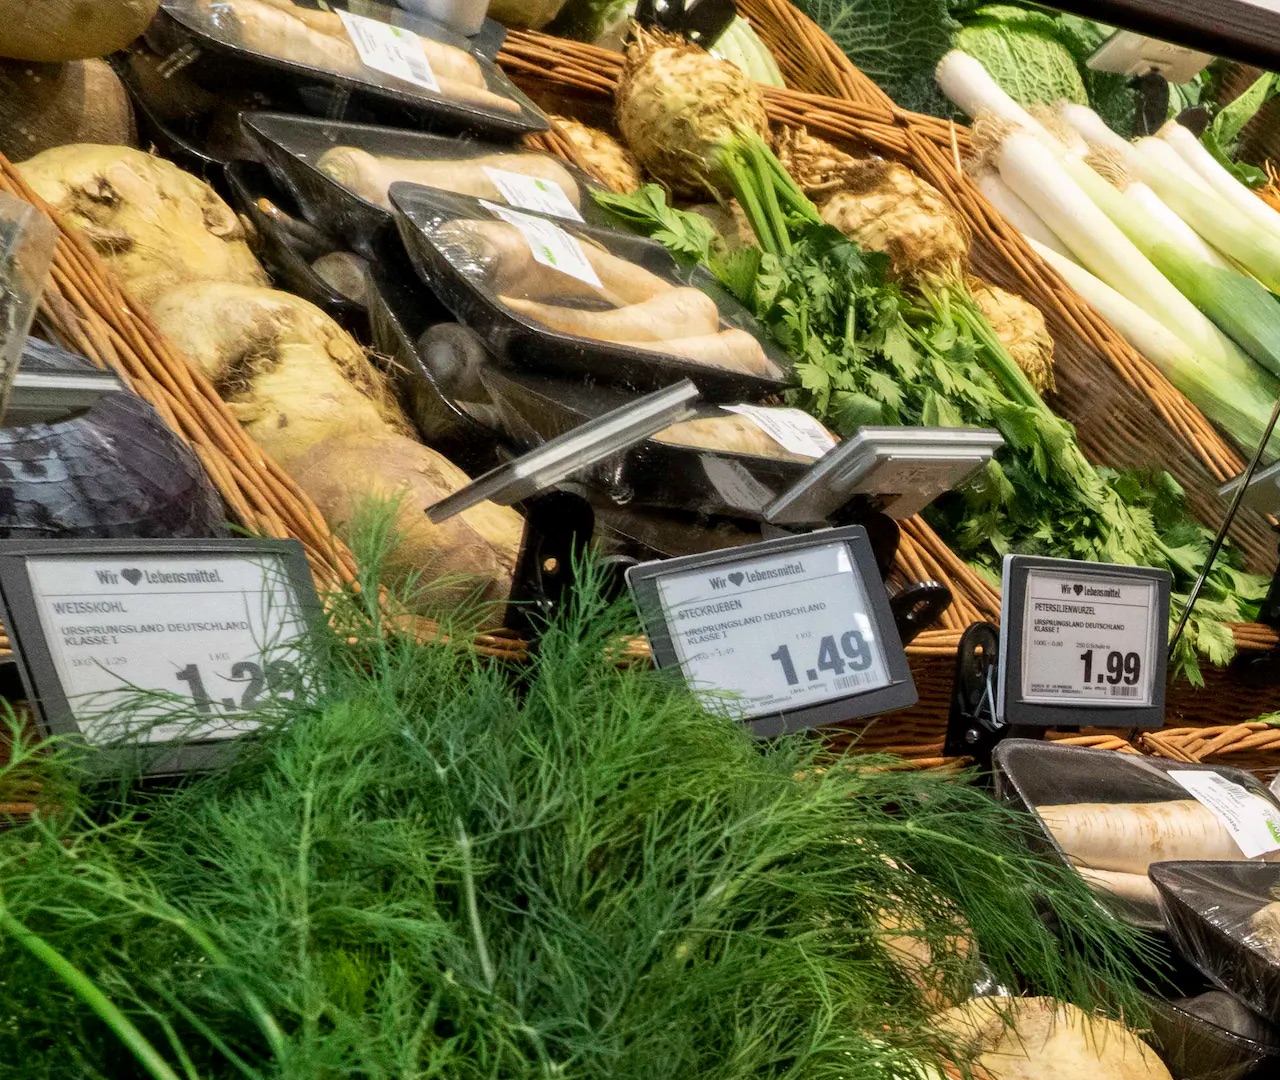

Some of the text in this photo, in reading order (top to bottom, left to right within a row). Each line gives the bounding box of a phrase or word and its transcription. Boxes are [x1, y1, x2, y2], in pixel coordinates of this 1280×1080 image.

[96, 568, 223, 585] Wir Lebensmittel.
[709, 562, 806, 591] Wir Lebensmittel.
[1060, 584, 1121, 598] Wir Lebensmittel.
[53, 601, 128, 615] WEISSKOHL
[678, 599, 743, 620] STECKRUEBEN
[1035, 603, 1095, 615] PETERSILIENWURZEL
[685, 602, 826, 637] URSPRUNGSLAND DEUTSCHLAND
[1034, 619, 1125, 630] URSPRUNGSLAND DEUTSCHLAND
[61, 621, 249, 636] URSPRUNGSLAND DEUTSCHLAND
[65, 635, 110, 646] KLASSE
[688, 634, 720, 645] KLASSE
[770, 630, 873, 686] 1.49
[1080, 650, 1141, 685] 1.99
